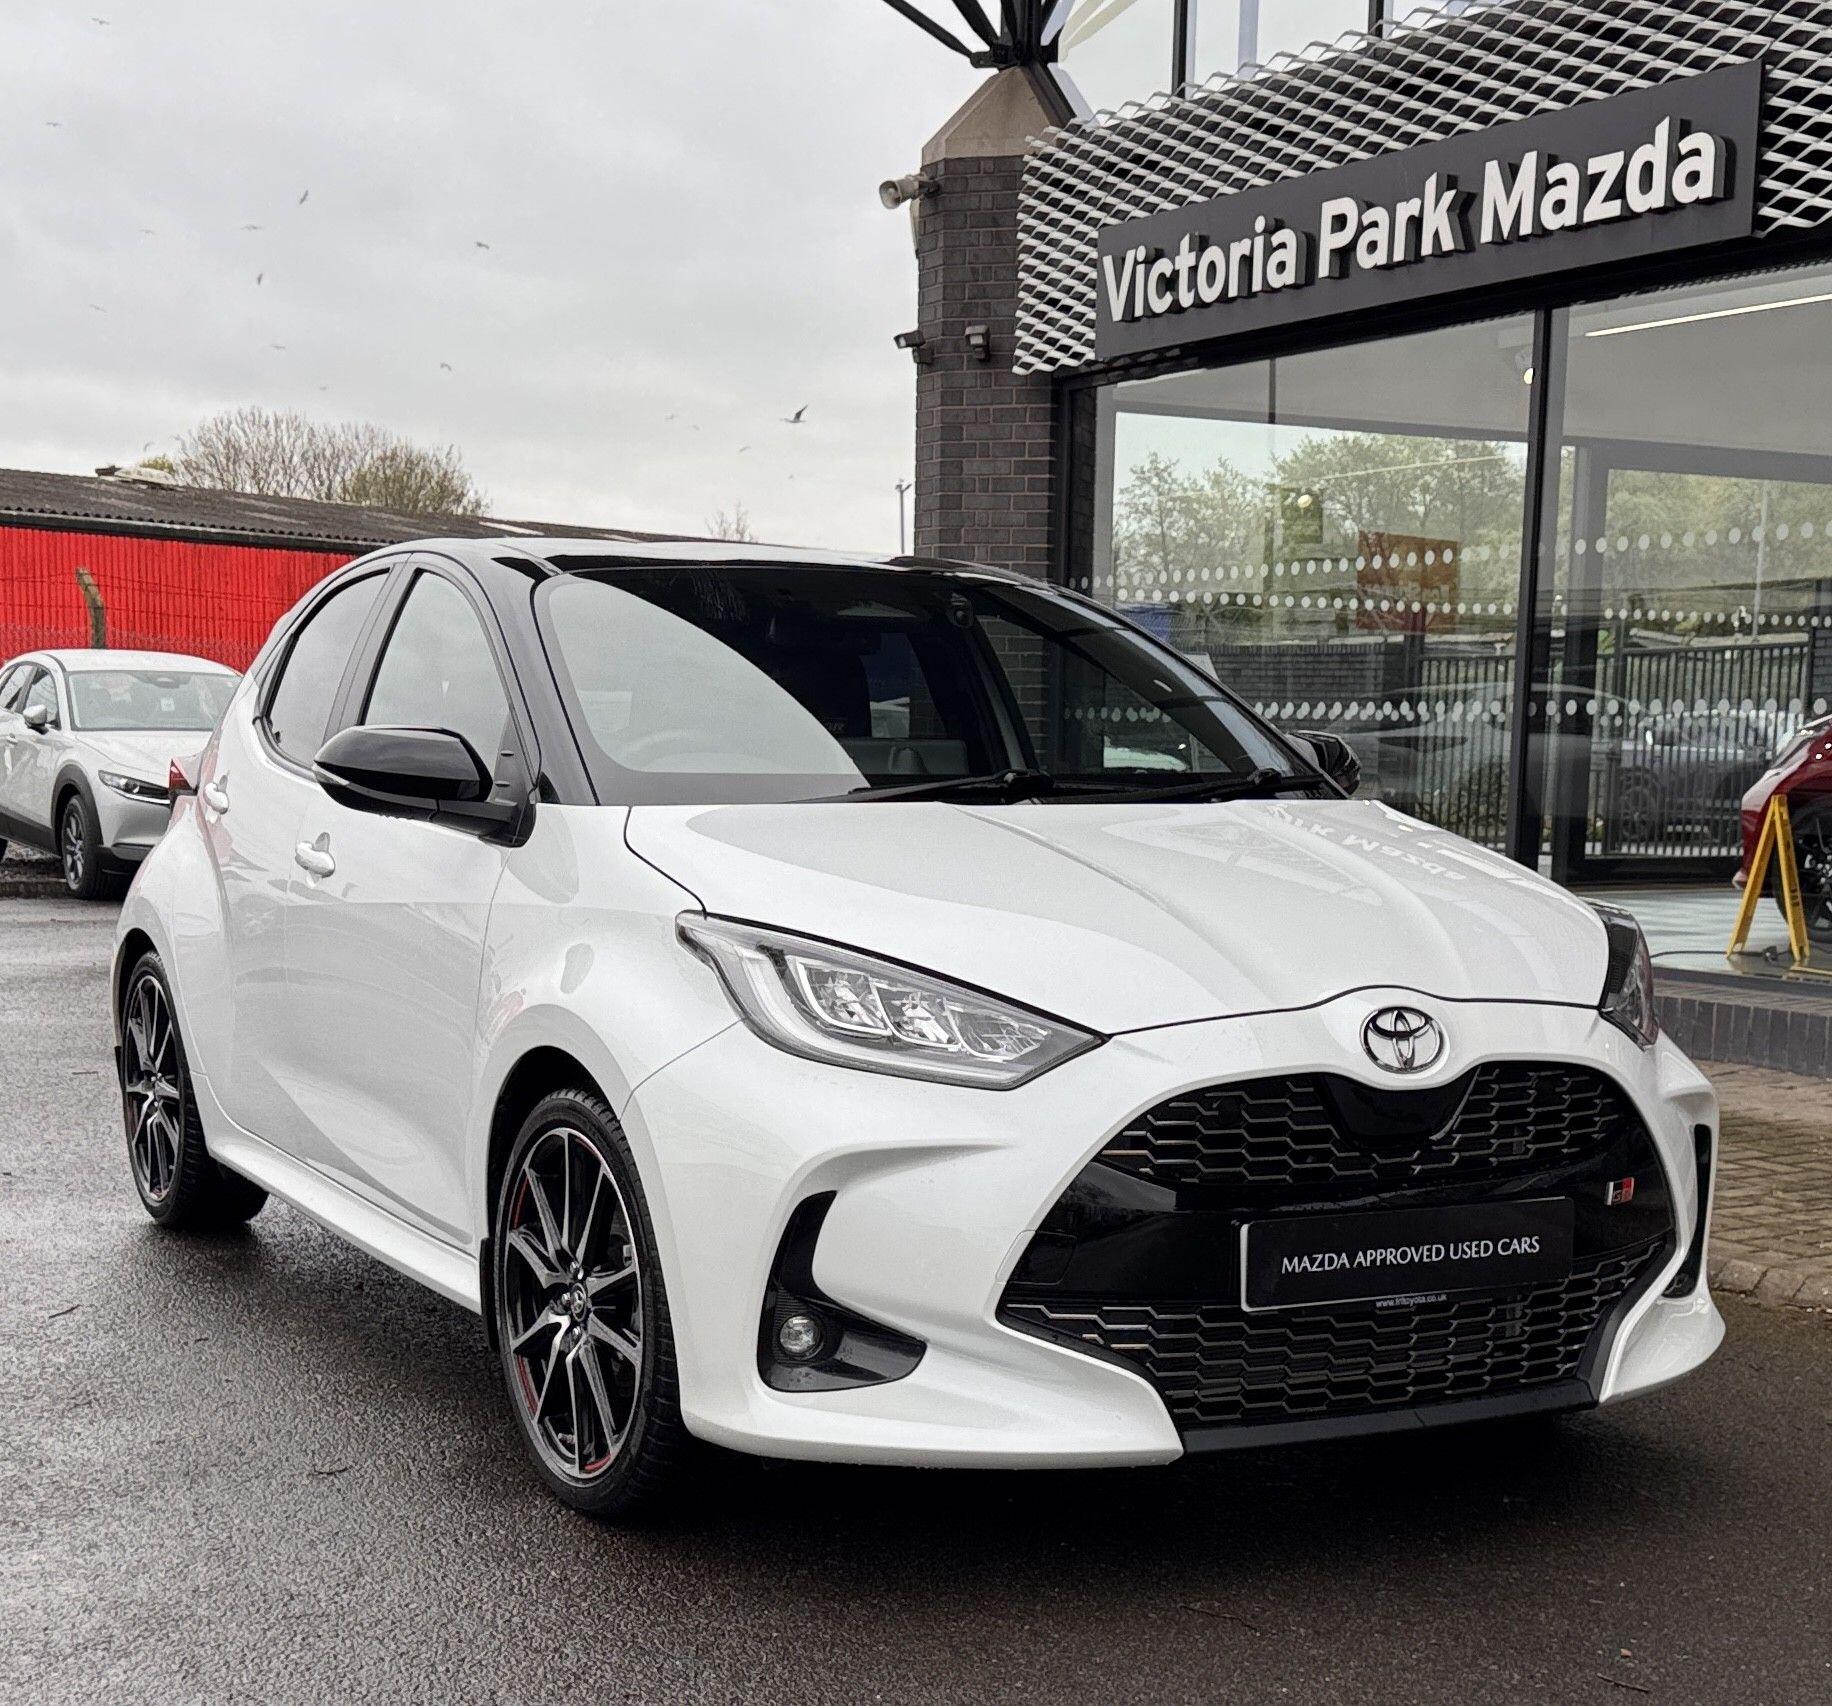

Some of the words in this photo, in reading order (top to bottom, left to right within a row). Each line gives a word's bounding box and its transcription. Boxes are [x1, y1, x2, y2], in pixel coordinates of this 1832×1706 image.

[1102, 214, 1300, 322] Victoria
[1318, 172, 1459, 279] Park
[1480, 115, 1718, 244] Mazda
[1281, 1251, 1350, 1275] MAZDA
[1353, 1243, 1446, 1268] APPROVED
[1449, 1239, 1494, 1261] USED
[1497, 1235, 1541, 1256] CARS
